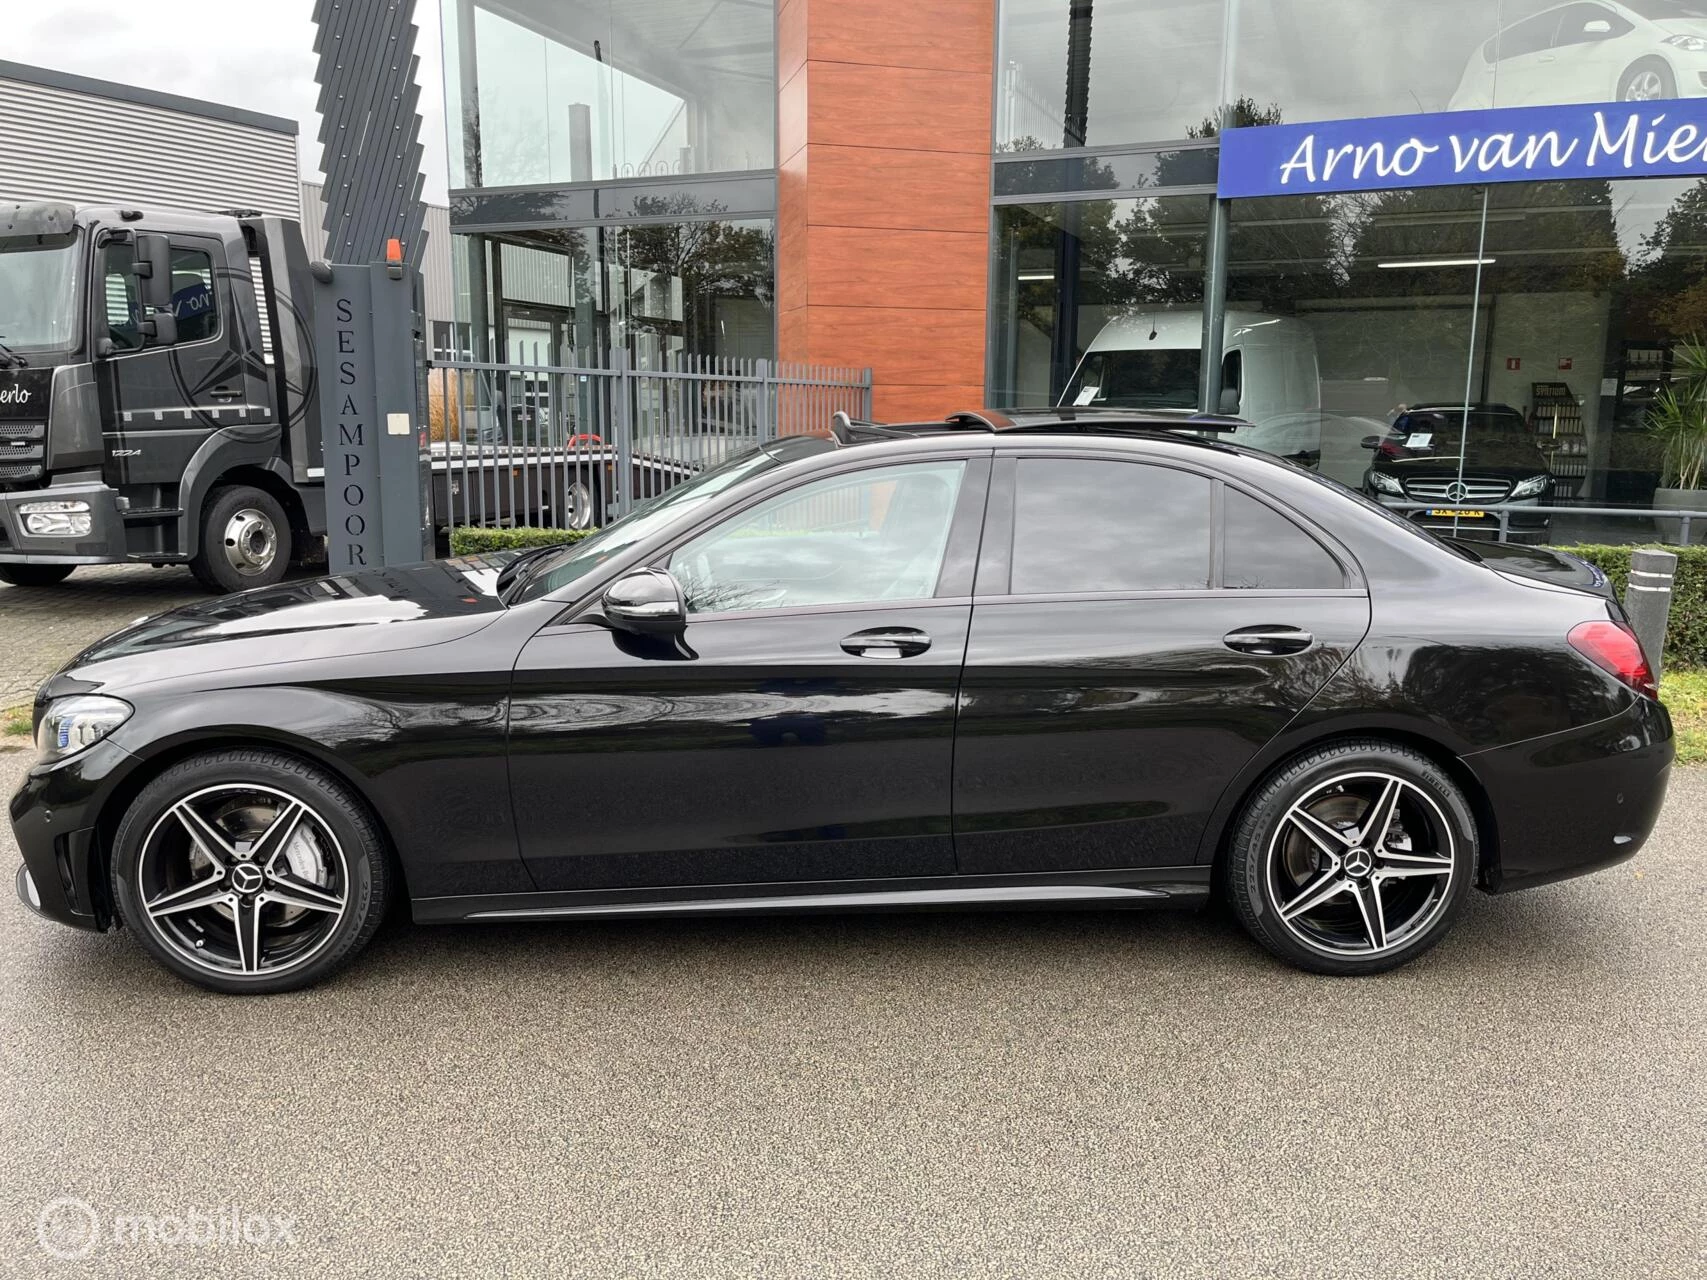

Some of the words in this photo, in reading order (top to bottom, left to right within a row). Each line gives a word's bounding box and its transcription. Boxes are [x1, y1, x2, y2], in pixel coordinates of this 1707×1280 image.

[1280, 134, 1439, 185] Arno
[1450, 130, 1578, 174] van
[1586, 111, 1707, 169] Mie
[112, 449, 142, 458] 1224
[336, 298, 367, 566] SESAMPOOR
